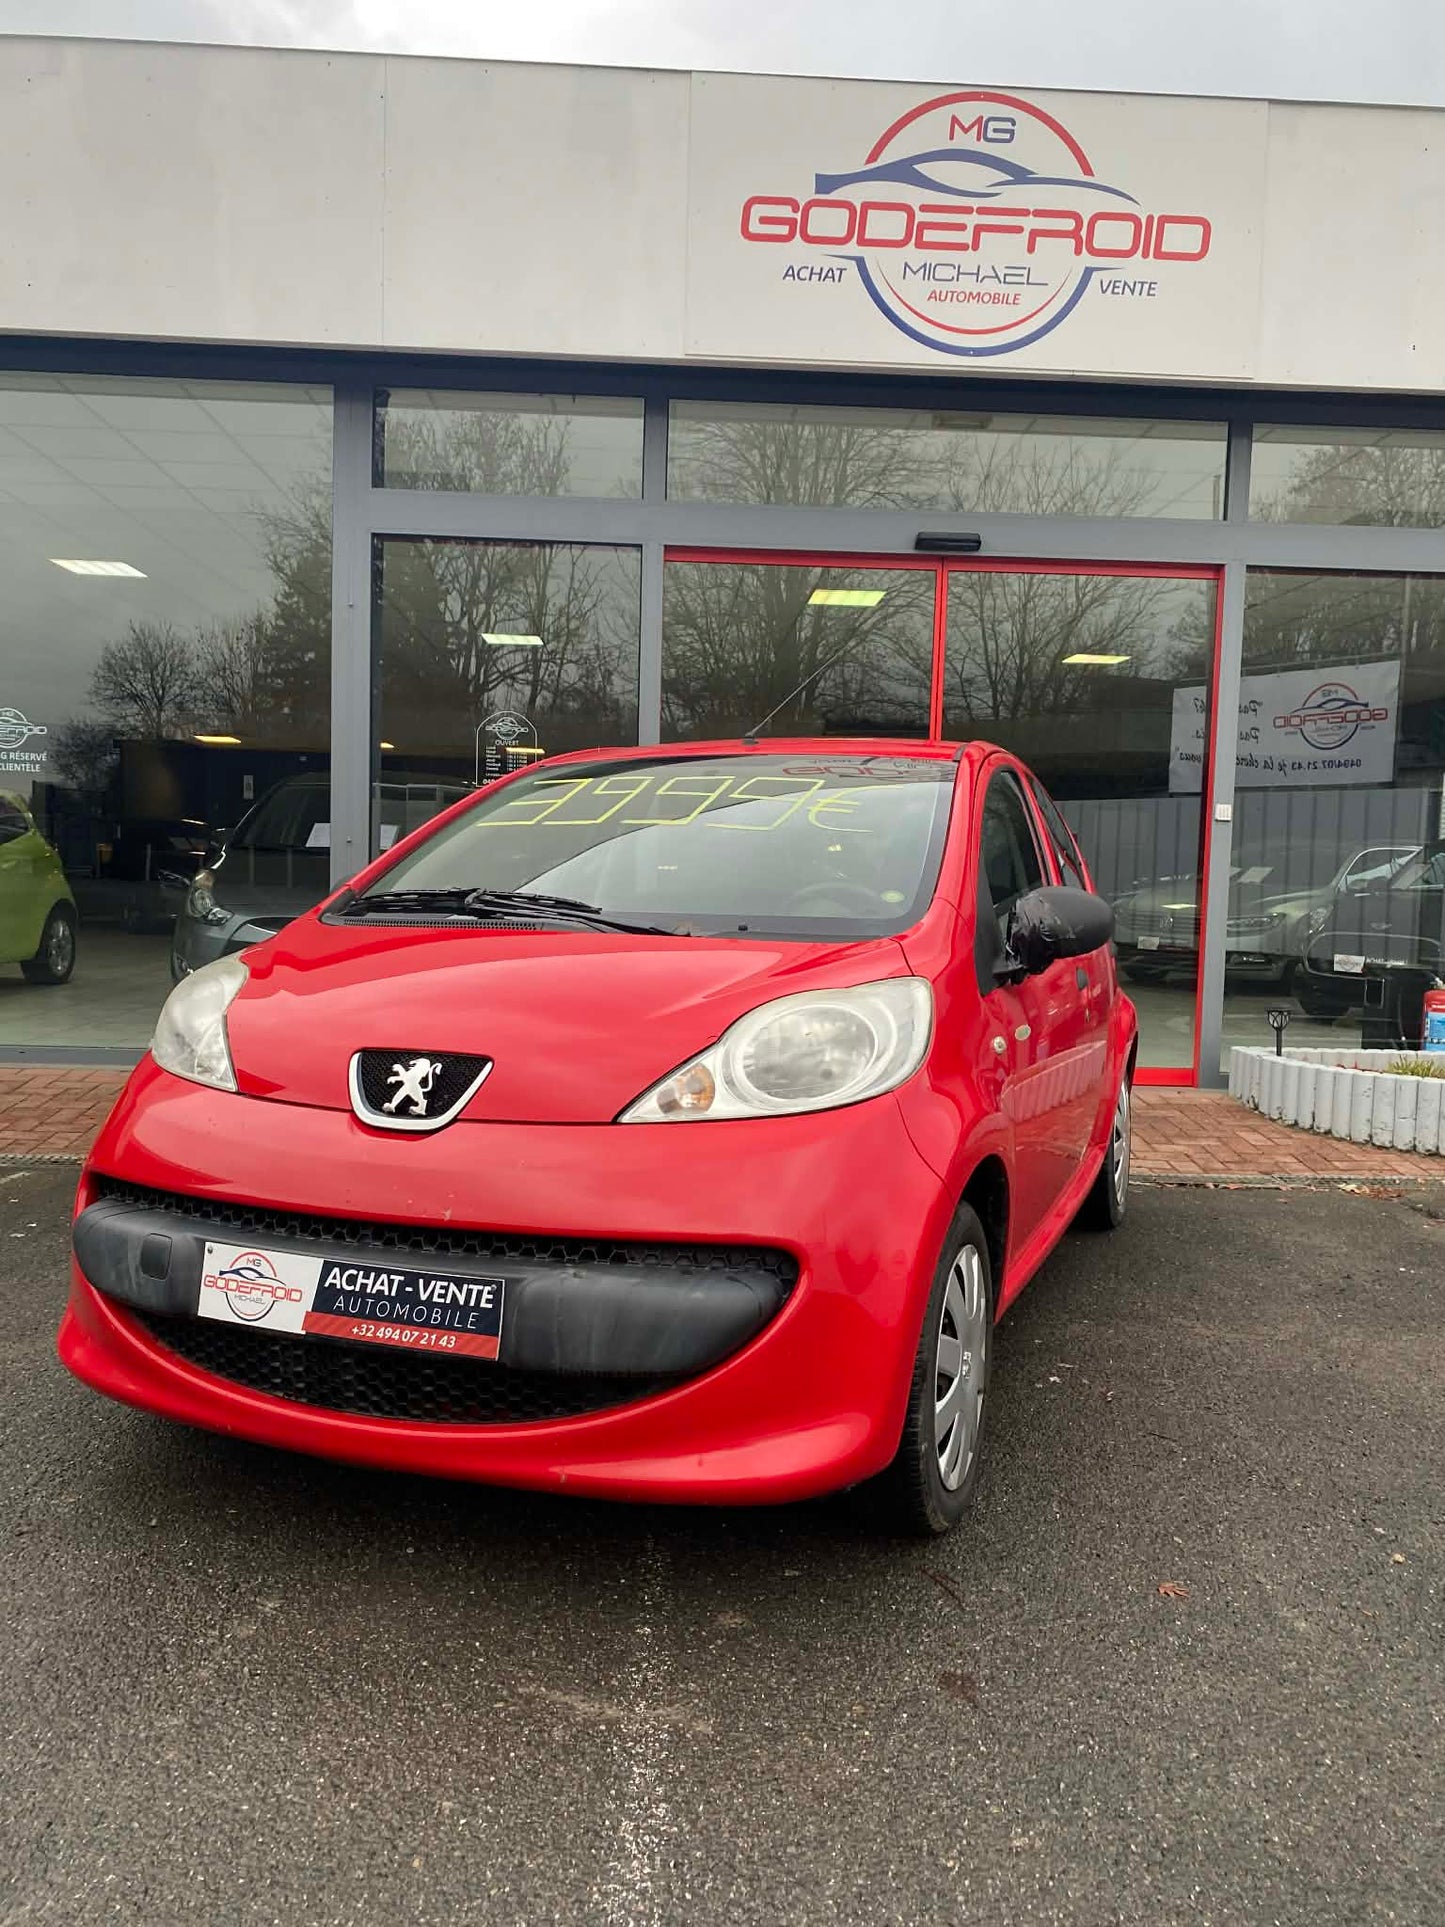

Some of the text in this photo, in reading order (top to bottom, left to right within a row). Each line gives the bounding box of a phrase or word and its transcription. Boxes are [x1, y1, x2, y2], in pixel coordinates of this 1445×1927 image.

[948, 114, 1016, 144] MG
[740, 196, 1212, 261] GODEFROID
[782, 264, 848, 284] ACHAT
[902, 261, 1048, 286] MICHAEL
[927, 289, 1022, 306] AUTOMOBILE
[1099, 278, 1158, 298] VENTE
[10, 751, 47, 761] RÉSERVÉ
[203, 1274, 303, 1302] GODEFROID
[324, 1266, 404, 1297] ACHAT
[418, 1278, 495, 1309] VENTE
[333, 1295, 480, 1329] AUTOMOBILE
[352, 1324, 375, 1337] +32
[376, 1327, 400, 1341] 494
